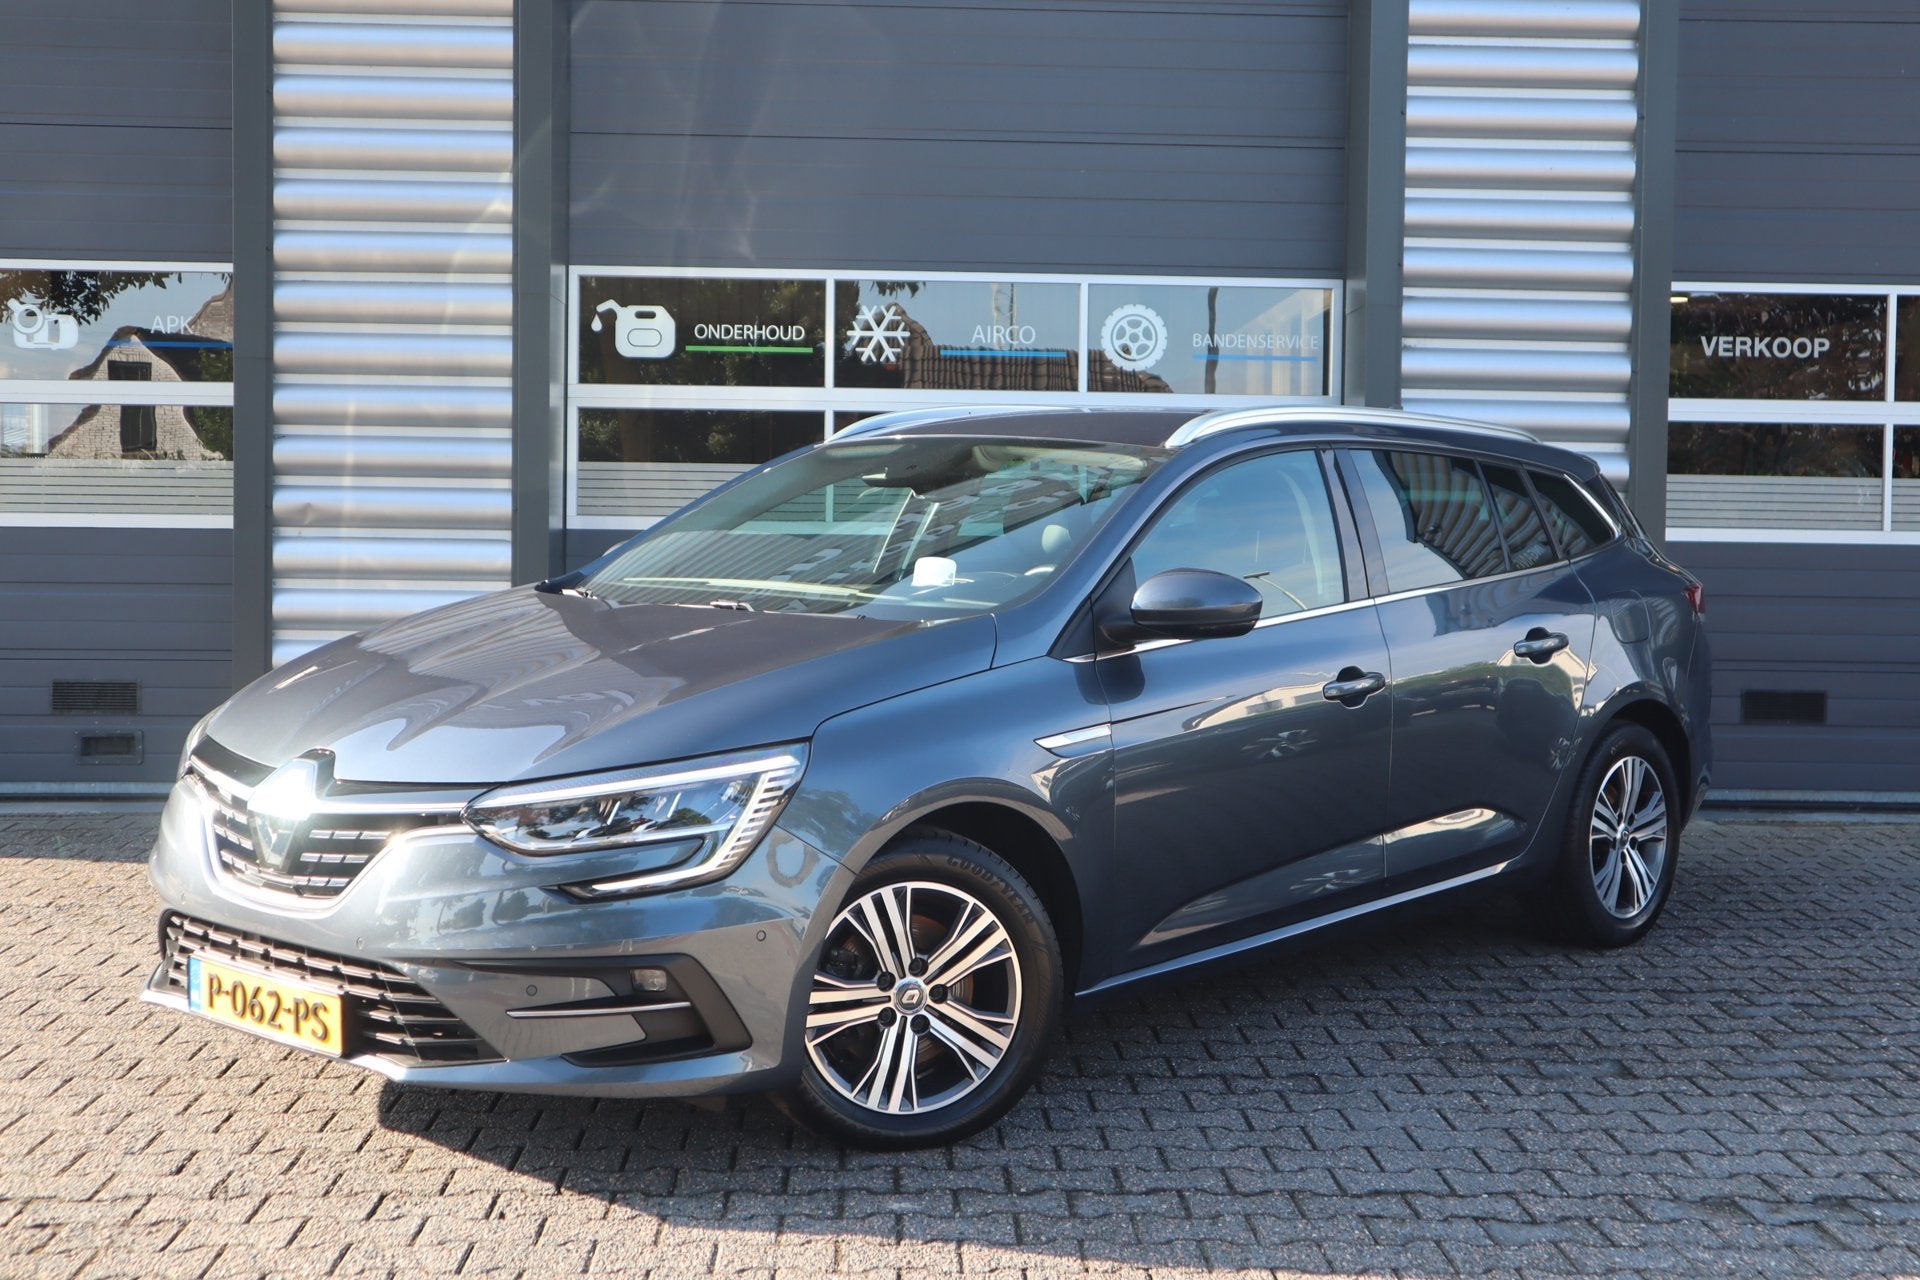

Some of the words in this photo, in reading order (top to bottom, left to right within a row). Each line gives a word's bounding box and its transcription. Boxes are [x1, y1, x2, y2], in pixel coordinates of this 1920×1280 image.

[150, 315, 194, 334] APK
[695, 323, 805, 341] ONDERHOUD
[972, 325, 1035, 344] AIRCO
[1192, 333, 1319, 349] BANDENSERVICE
[1701, 336, 1830, 358] VERKOOP
[208, 973, 328, 1041] P-062-PS
